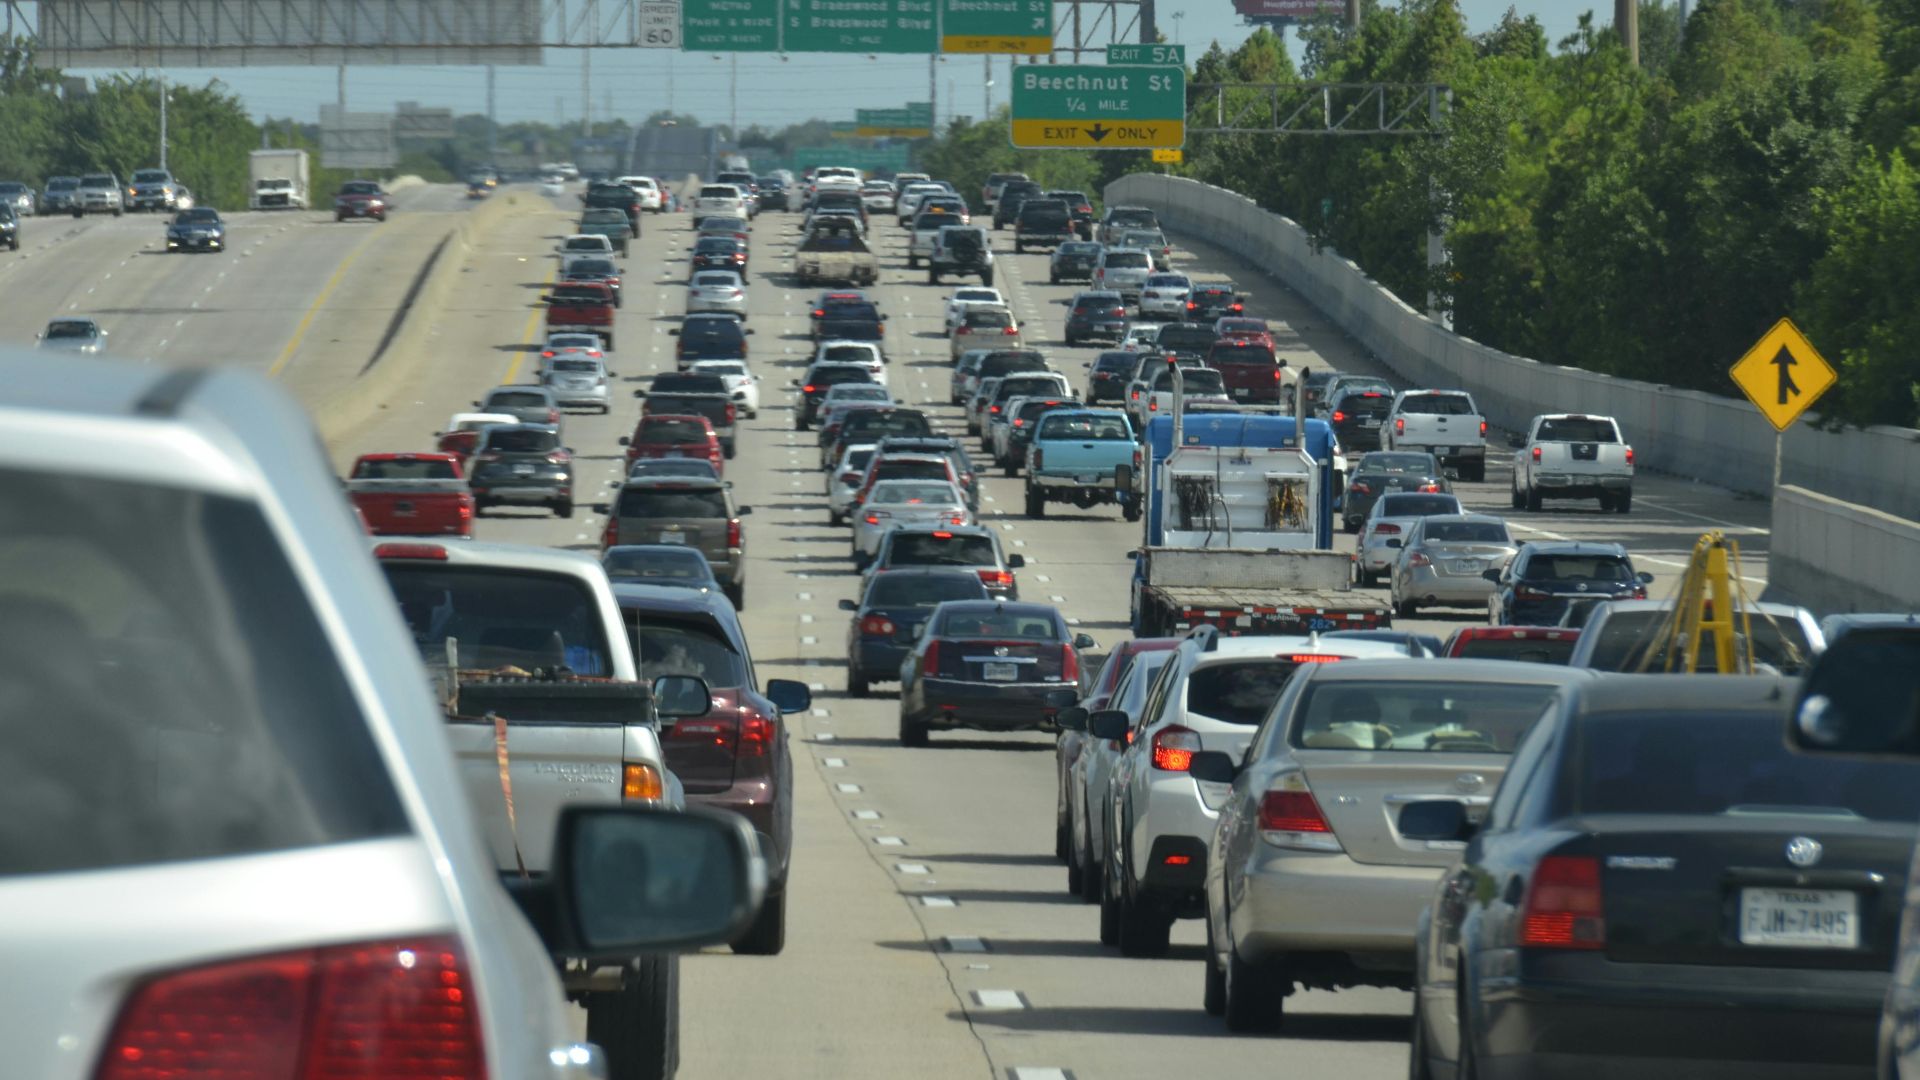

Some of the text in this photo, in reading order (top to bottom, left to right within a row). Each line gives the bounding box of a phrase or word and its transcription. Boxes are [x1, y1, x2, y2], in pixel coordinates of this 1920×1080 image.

[641, 5, 677, 13] SPEED
[897, 1, 931, 11] Blvd
[949, 0, 1045, 11] Beechnut St
[688, 18, 773, 26] PARK & RIDE
[791, 17, 931, 29] S Braeswood Blvd
[647, 29, 673, 43] 60
[1111, 48, 1180, 63] EXIT 5A
[1024, 74, 1172, 91] Beechnut St
[1098, 100, 1129, 111] MILE
[1043, 127, 1158, 140] EXIT ONLY
[1777, 892, 1821, 904] TEXAS
